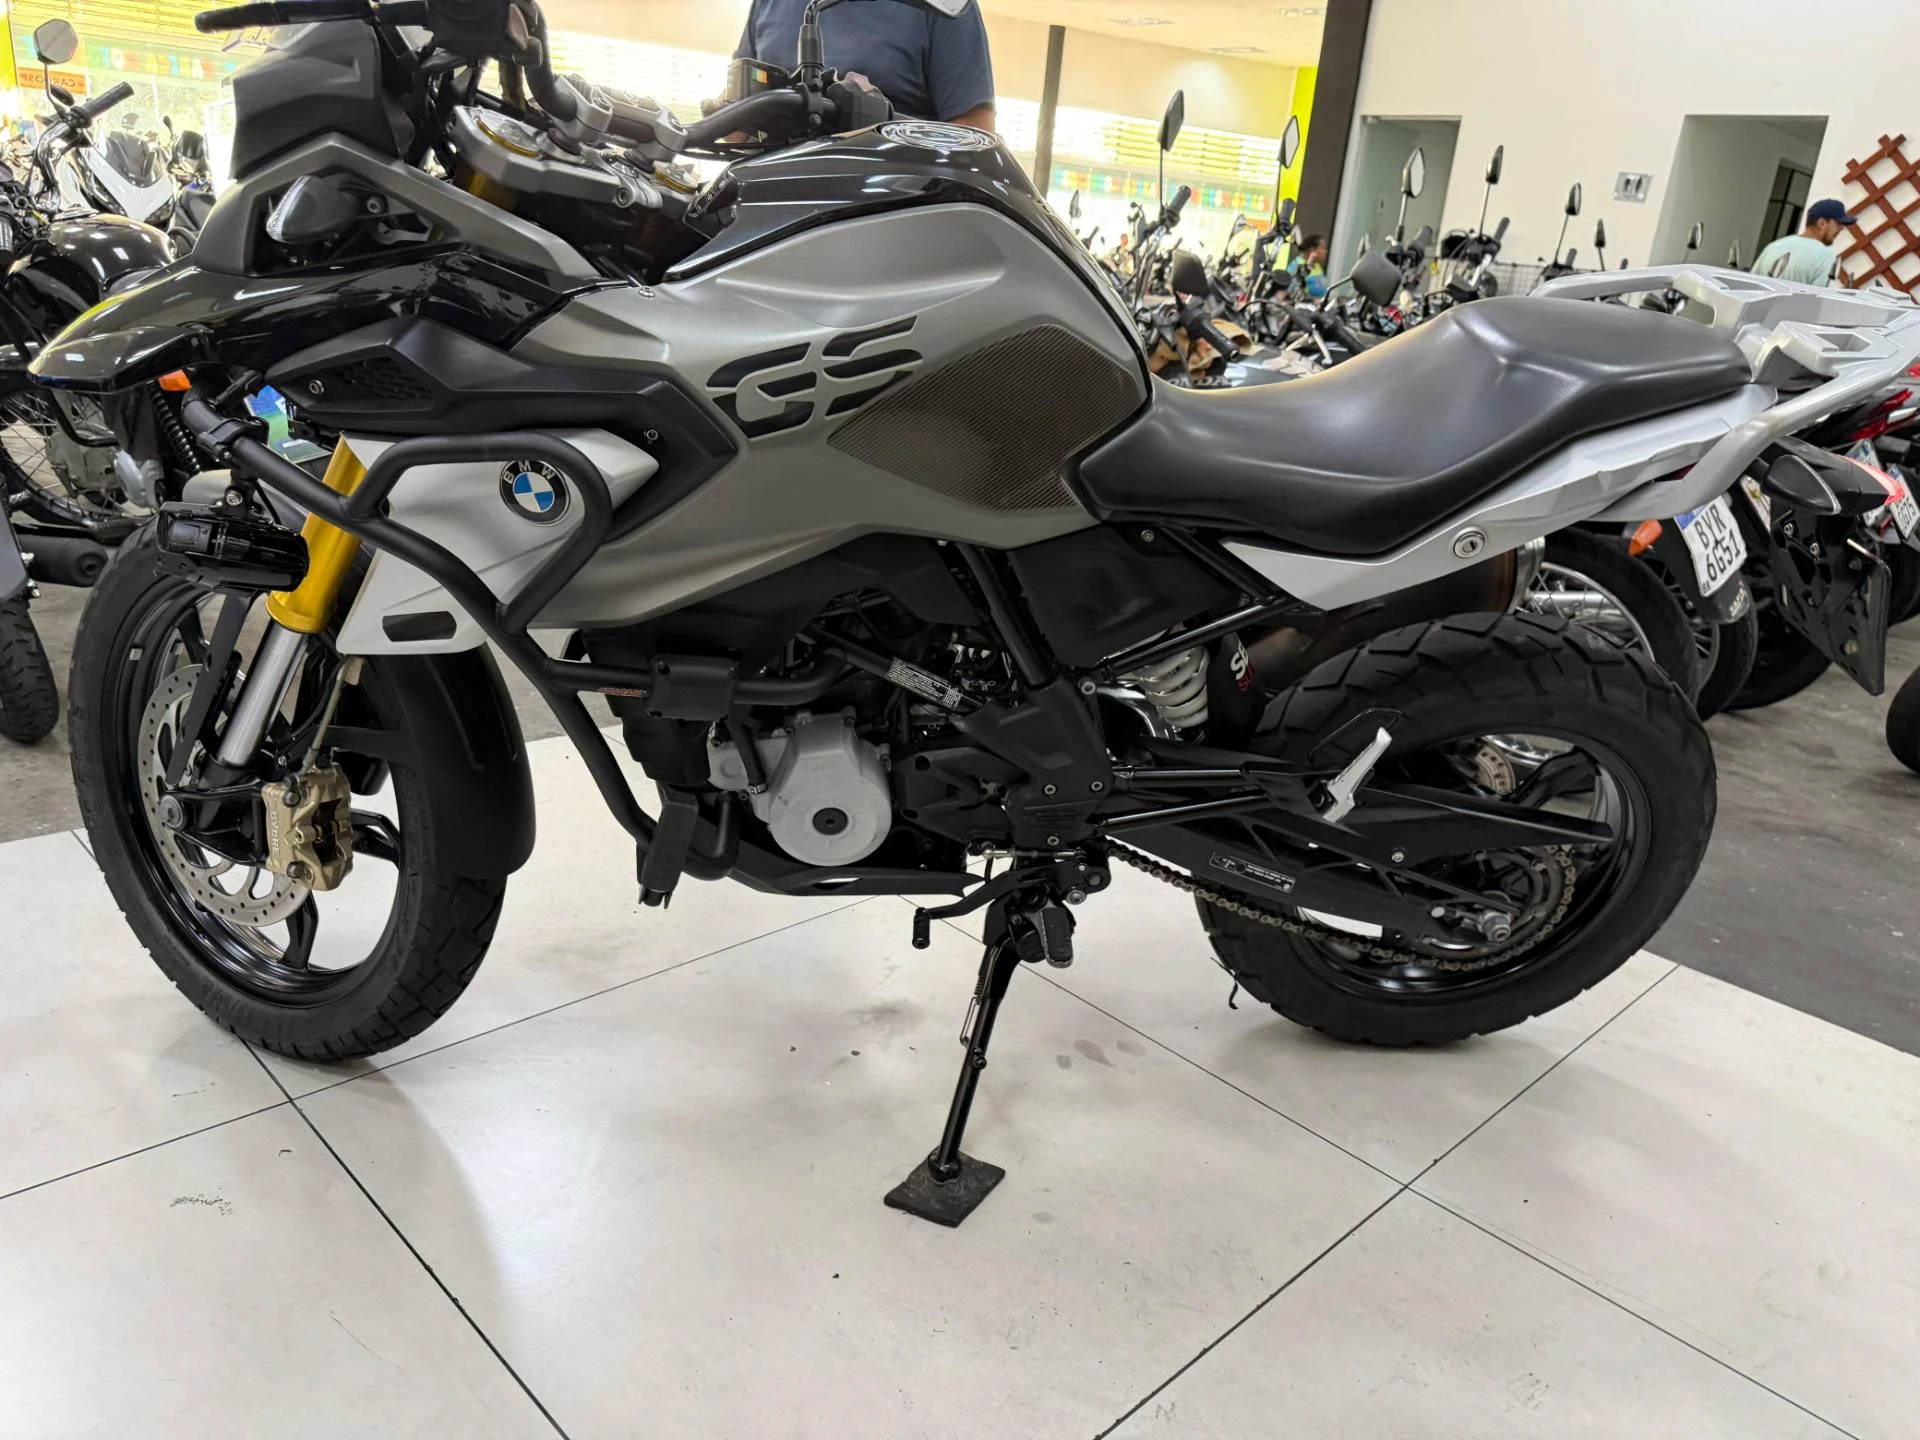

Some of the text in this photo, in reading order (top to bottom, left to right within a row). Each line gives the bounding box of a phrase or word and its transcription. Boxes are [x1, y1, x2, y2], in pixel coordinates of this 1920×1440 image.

[1167, 375, 1229, 388] ONDA
[503, 460, 556, 485] BMW
[1694, 503, 1727, 550] BYR
[1706, 528, 1741, 582] 6G51
